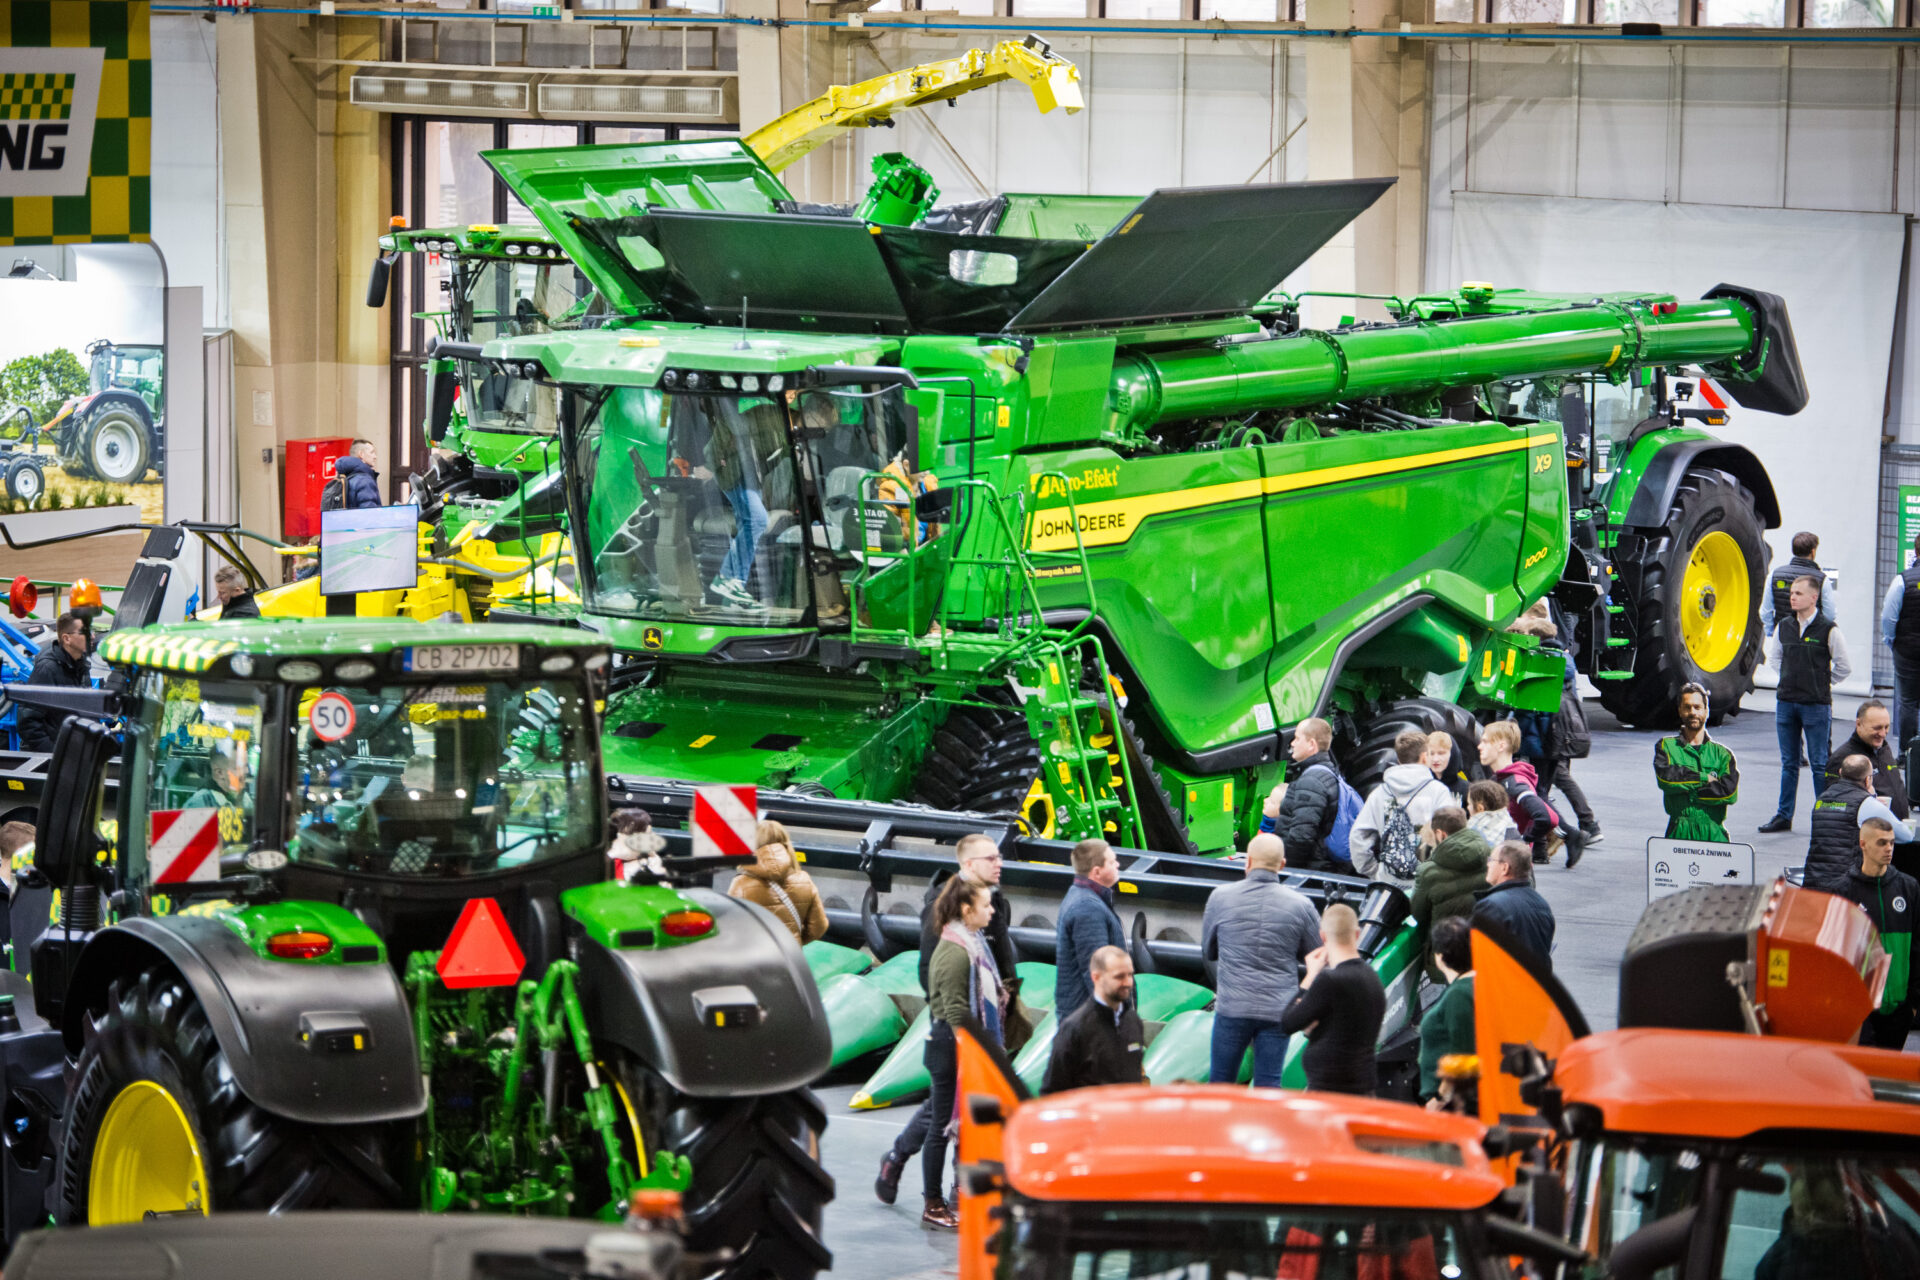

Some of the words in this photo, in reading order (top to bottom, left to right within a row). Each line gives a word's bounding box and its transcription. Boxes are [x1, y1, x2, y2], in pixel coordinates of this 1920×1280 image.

[1534, 454, 1552, 473] X9
[1037, 520, 1075, 538] JOHN
[1079, 513, 1126, 532] DEERE
[1525, 547, 1548, 568] 1000
[416, 648, 442, 669] CB
[451, 646, 513, 668] 2P702
[317, 706, 347, 728] 50
[1673, 847, 1705, 856] OBIETNICA
[1706, 849, 1732, 857] ŻNIWNA
